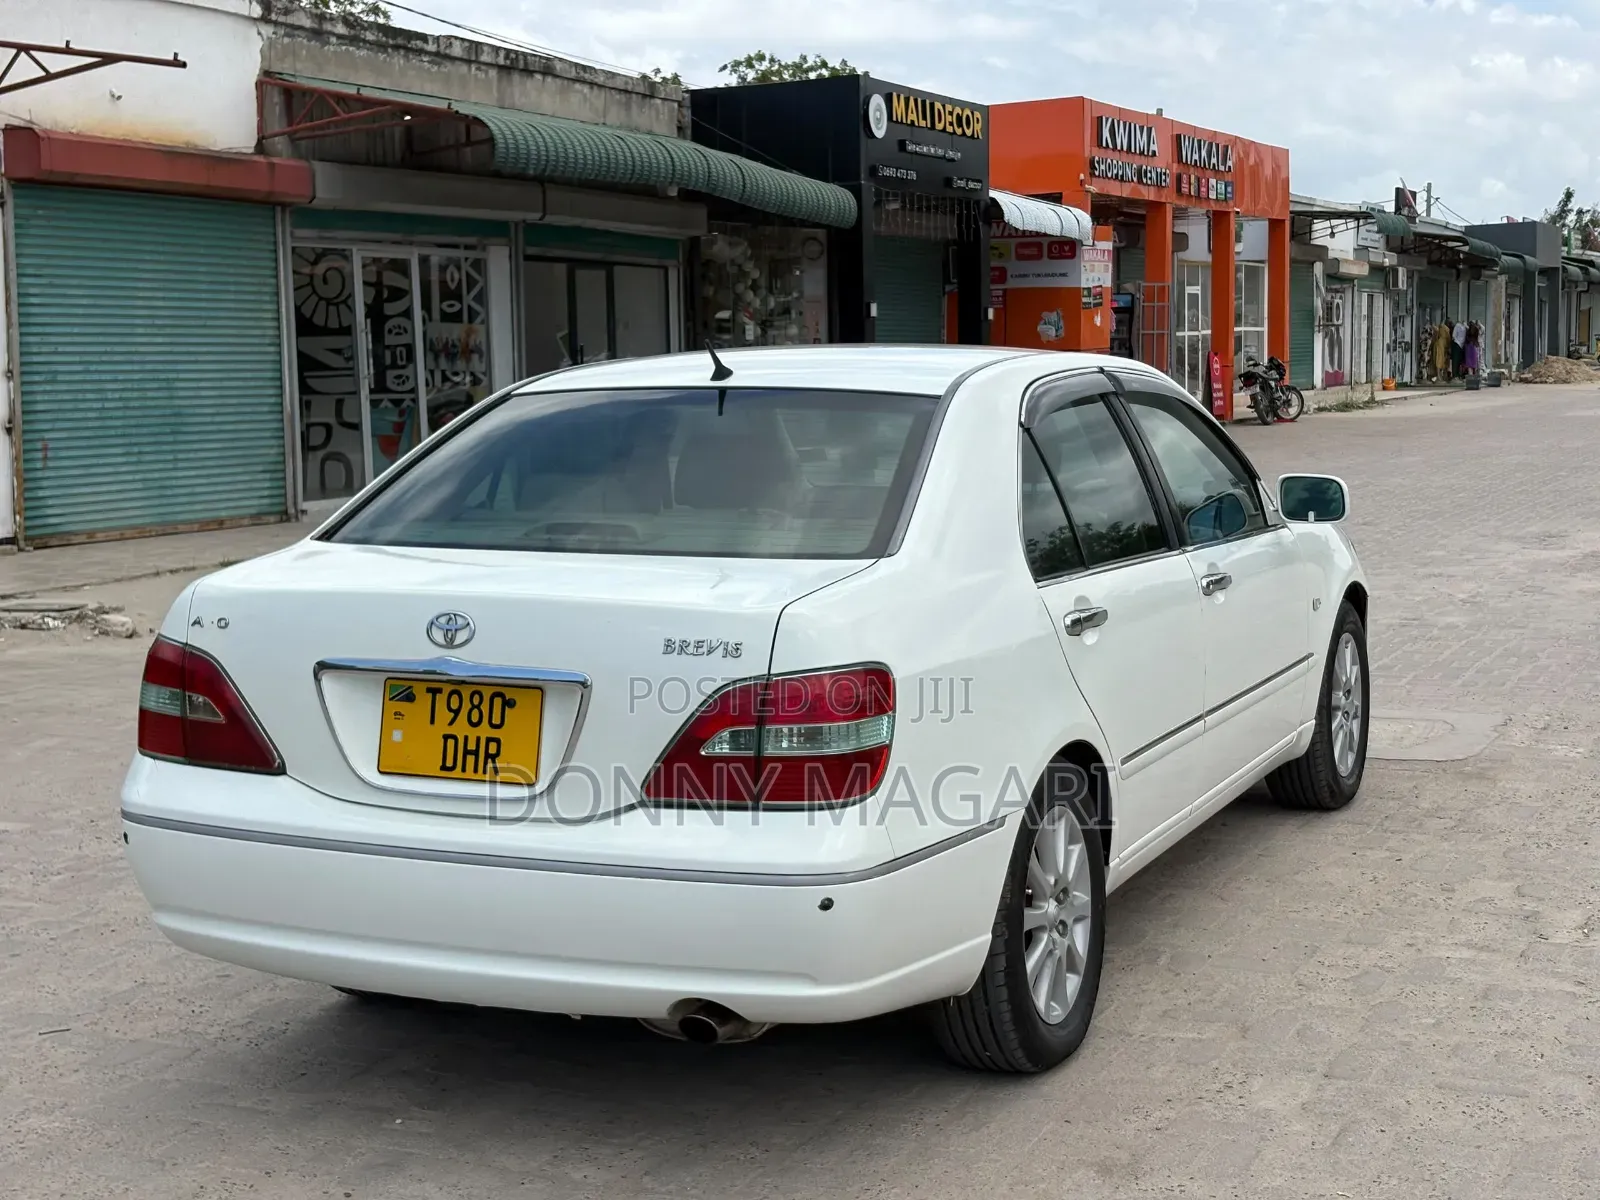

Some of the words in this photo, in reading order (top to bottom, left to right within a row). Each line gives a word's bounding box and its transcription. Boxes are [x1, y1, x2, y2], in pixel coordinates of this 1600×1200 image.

[892, 92, 931, 128] MALI
[934, 101, 982, 139] DECOR
[1101, 115, 1159, 157] KWIMA
[1180, 133, 1234, 172] WAKALA
[1094, 155, 1138, 182] SHOPPING
[1142, 165, 1171, 187] CENTER
[1083, 249, 1109, 261] WAKALA
[662, 637, 743, 658] BREVIS
[425, 687, 507, 730] T980
[440, 734, 502, 776] DHR
